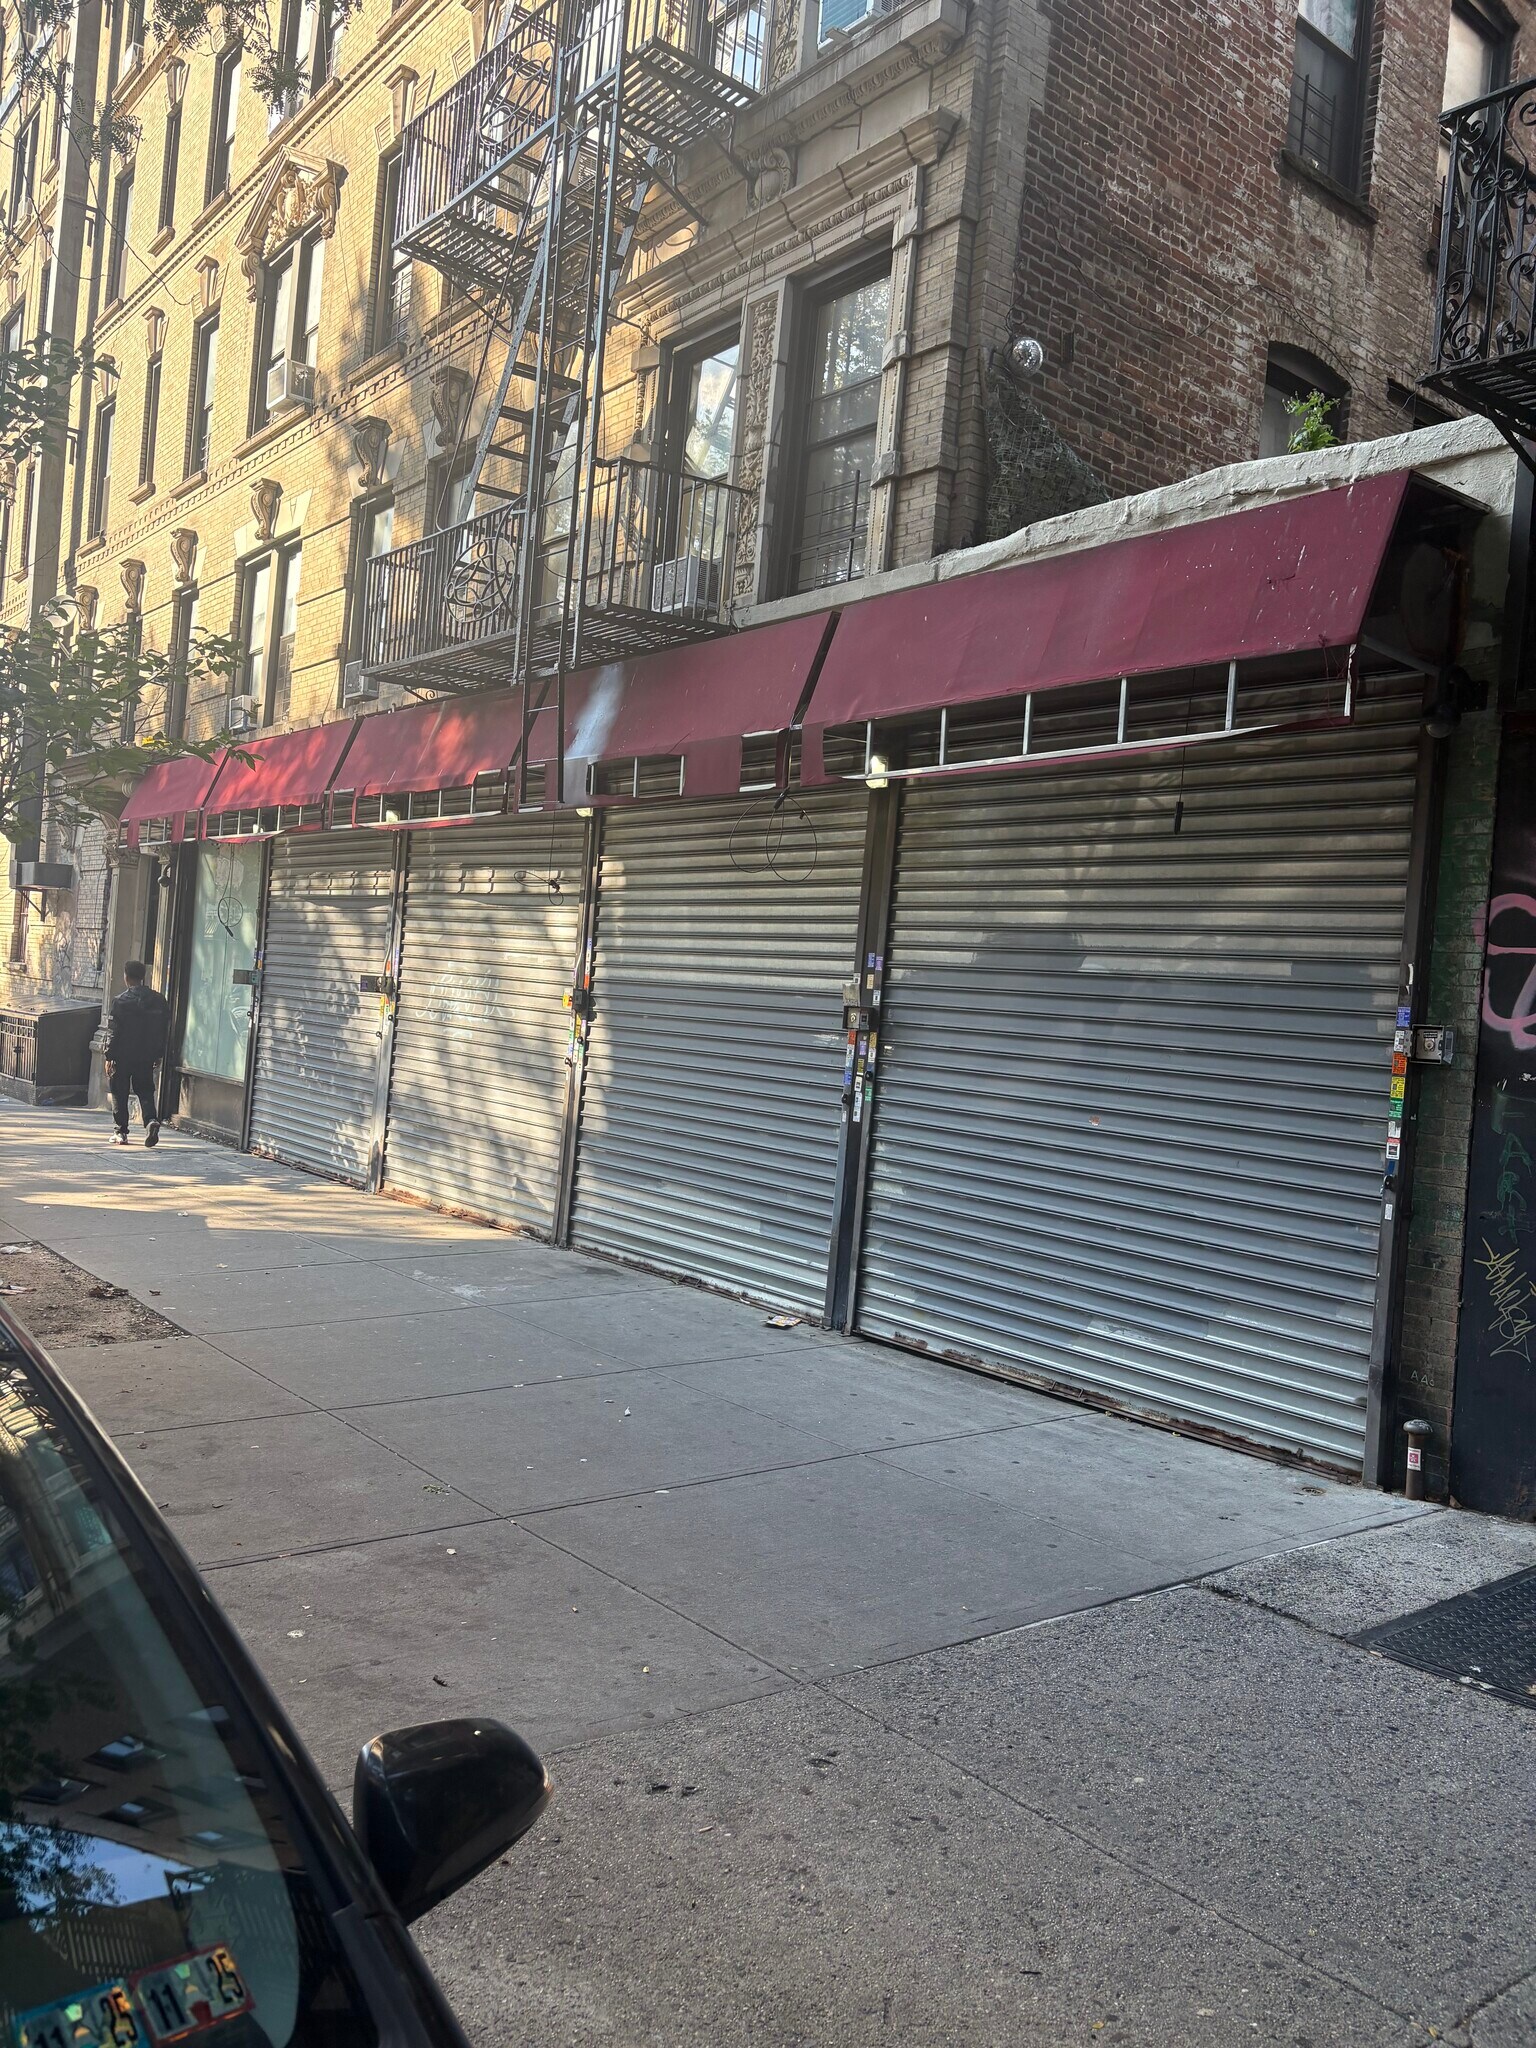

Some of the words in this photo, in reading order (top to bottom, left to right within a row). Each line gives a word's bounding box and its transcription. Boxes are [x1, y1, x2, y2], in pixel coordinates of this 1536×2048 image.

[99, 1990, 138, 2048] 25
[148, 1984, 186, 2030] 11
[205, 1952, 244, 2004] 25
